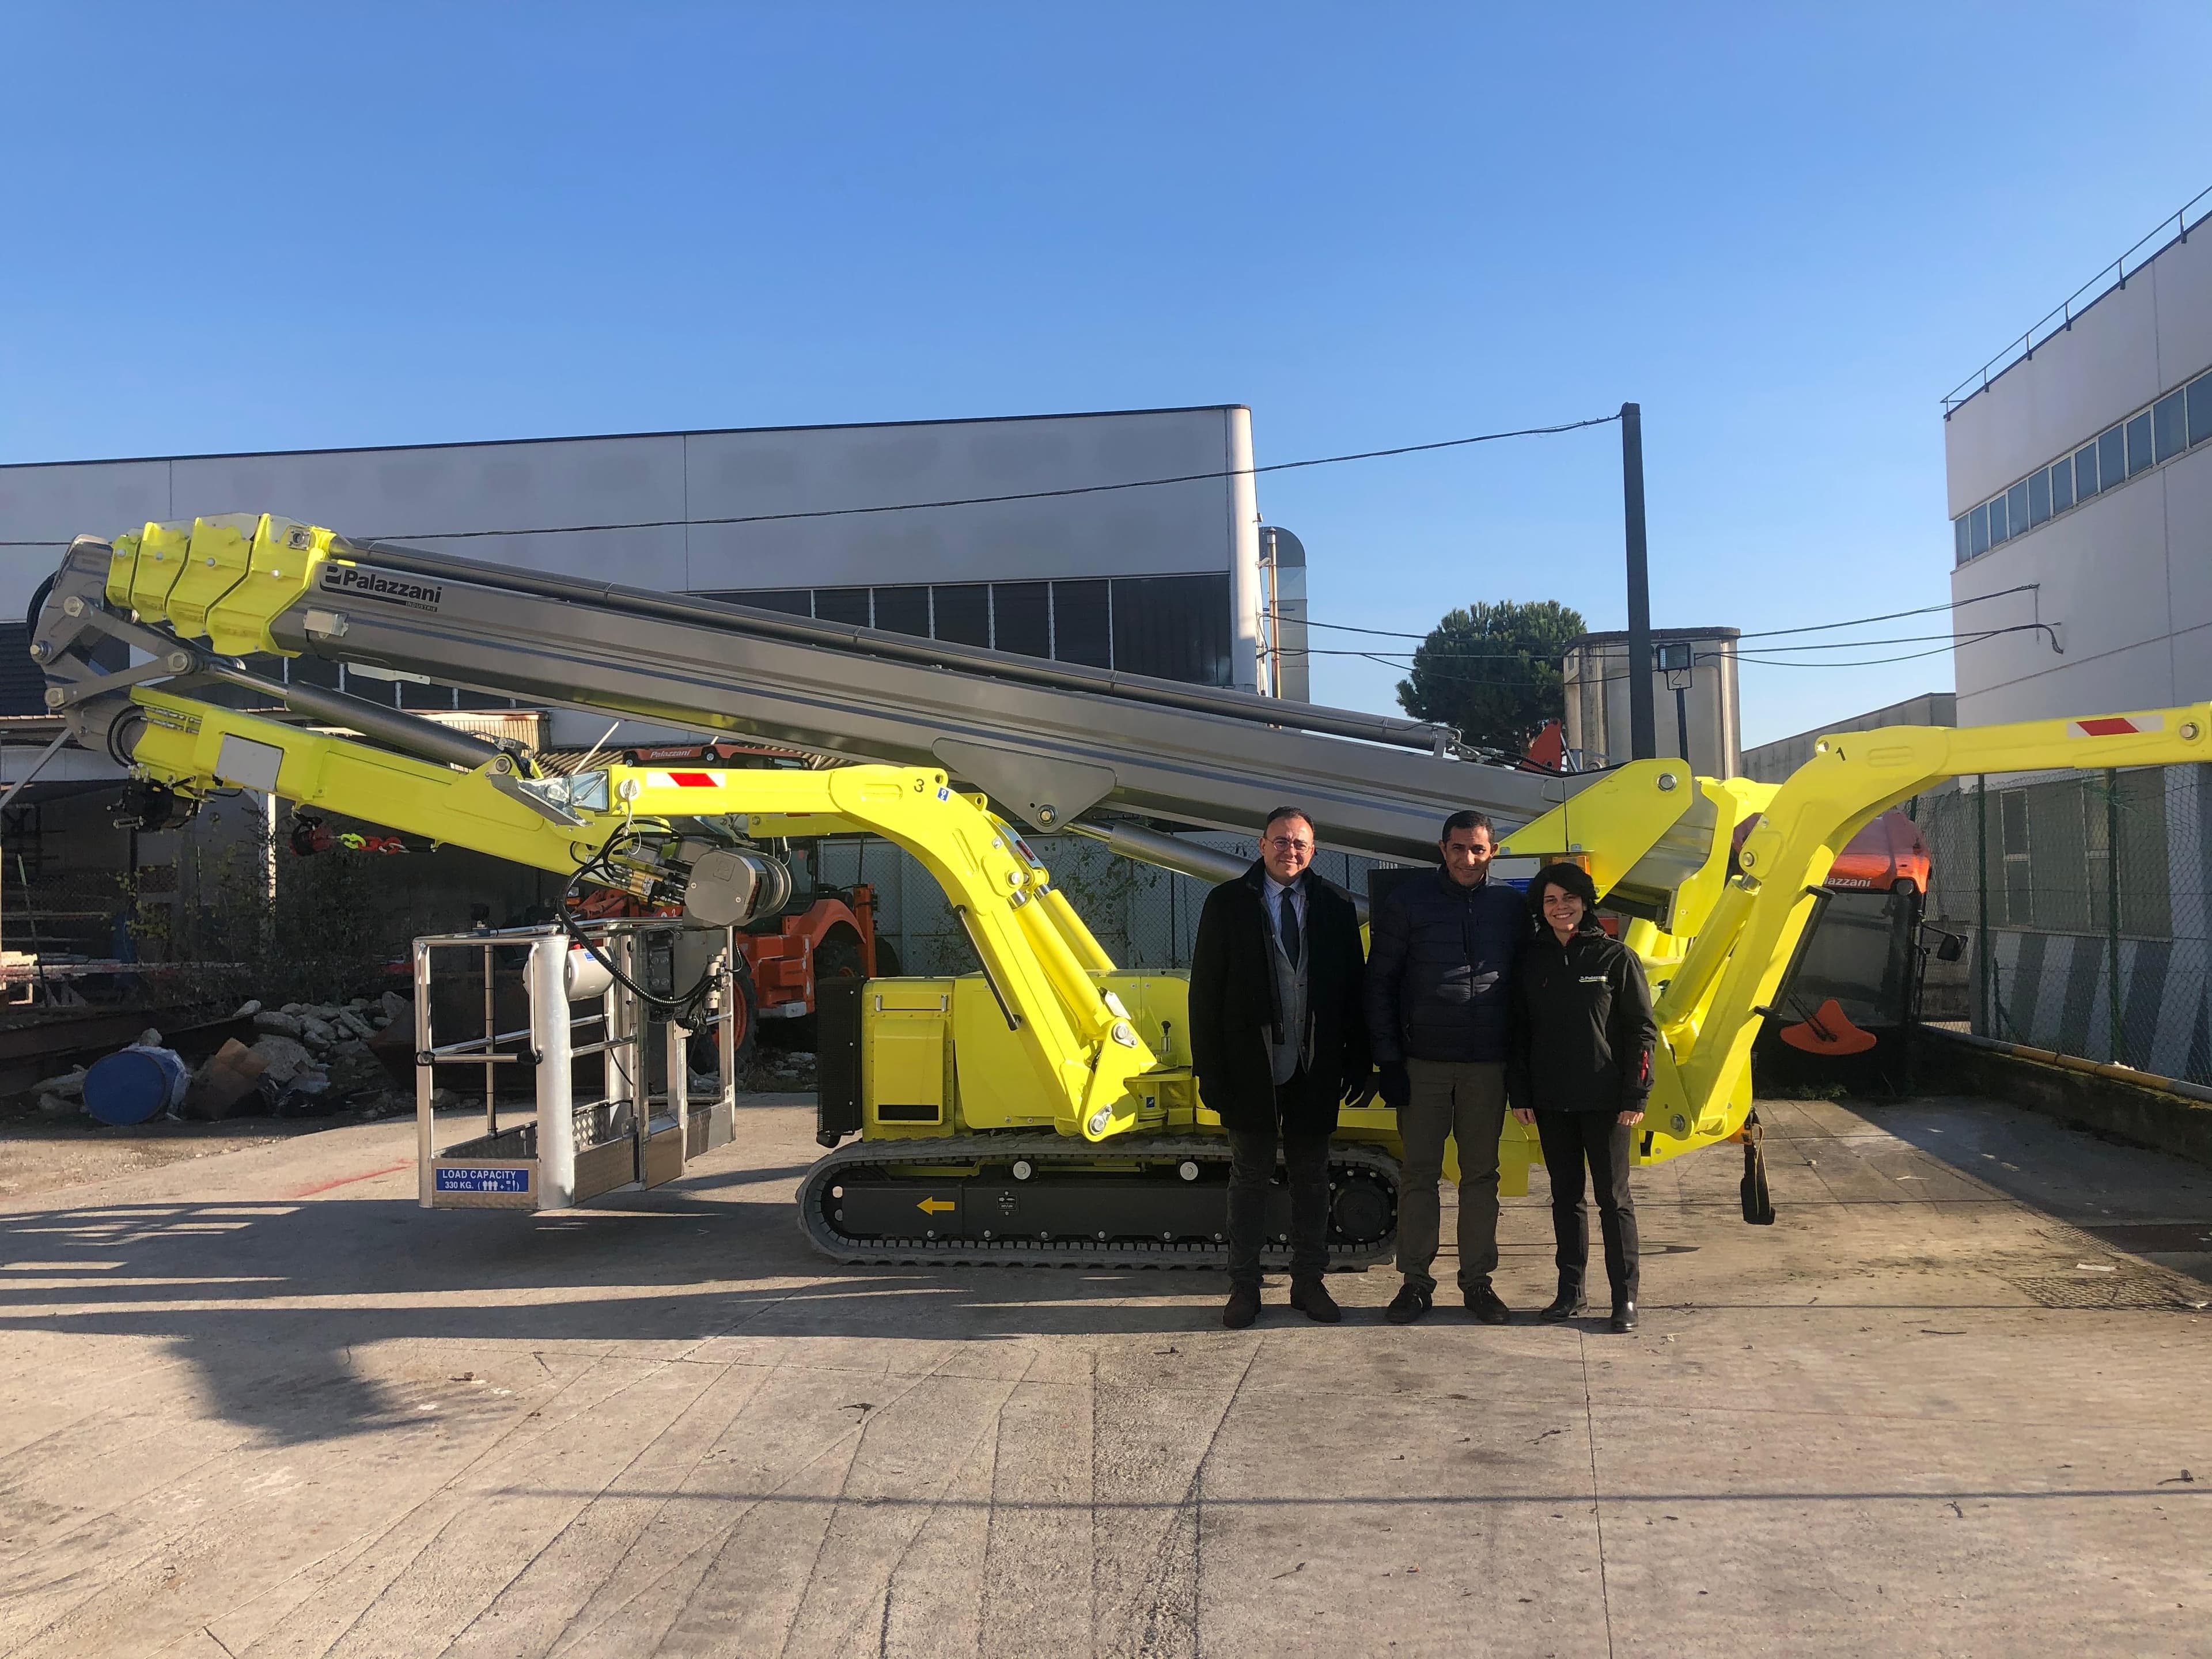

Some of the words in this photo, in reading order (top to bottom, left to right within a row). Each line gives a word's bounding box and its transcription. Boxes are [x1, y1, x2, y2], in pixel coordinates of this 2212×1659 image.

[343, 569, 442, 603] Palazzani
[650, 749, 691, 759] Palazzani
[1836, 747, 1846, 761] 1
[914, 778, 925, 793] 3
[1824, 875, 1872, 887] lazzani
[442, 1170, 467, 1179] LOAD
[470, 1171, 516, 1179] CAPACITY
[445, 1181, 458, 1189] 330
